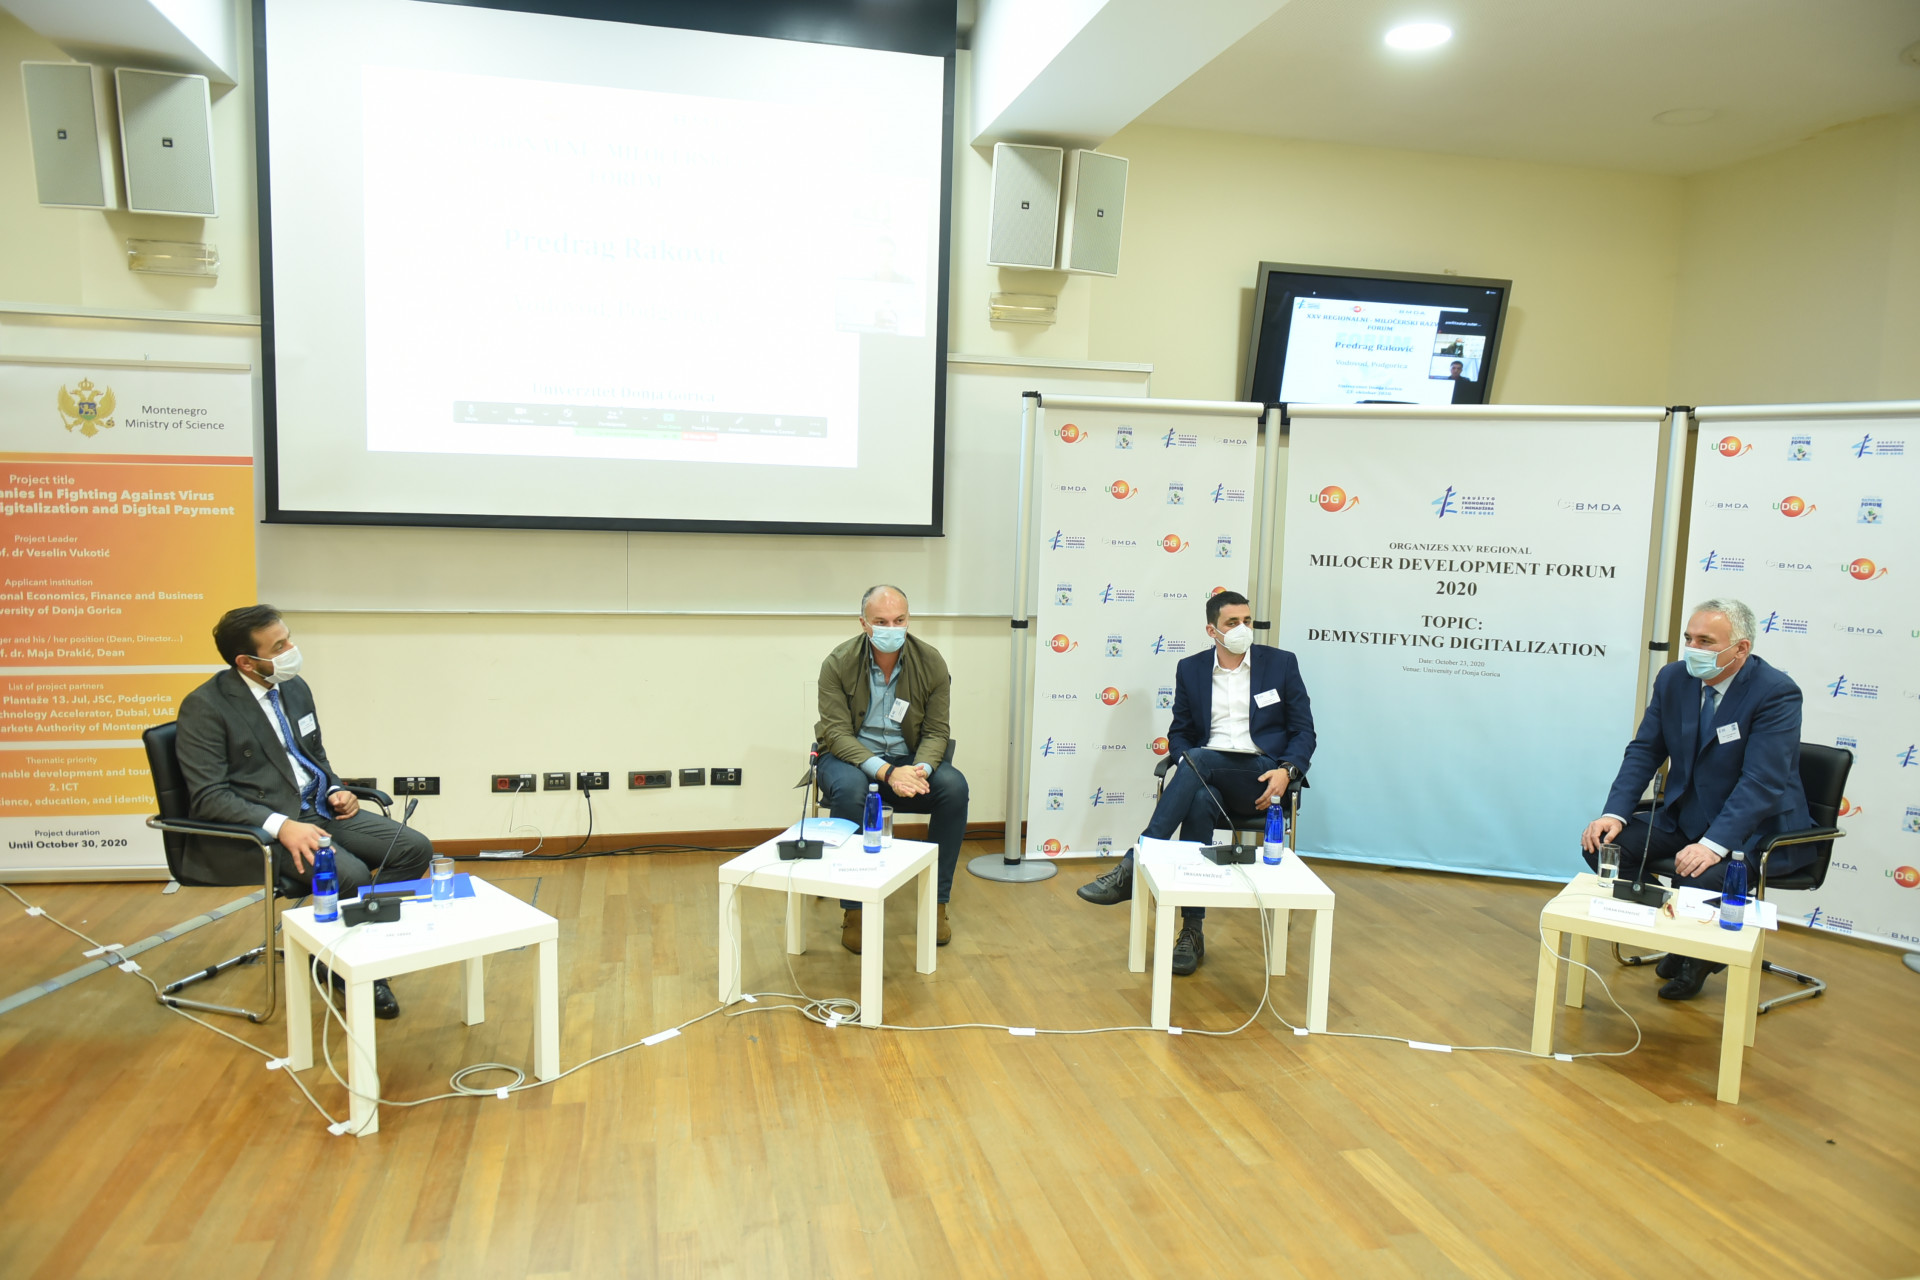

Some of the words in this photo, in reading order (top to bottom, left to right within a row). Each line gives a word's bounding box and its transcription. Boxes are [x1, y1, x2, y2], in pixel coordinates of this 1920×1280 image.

[503, 227, 617, 263] Predrag
[1335, 341, 1374, 352] Predrag
[141, 405, 208, 417] Montenegro
[125, 419, 169, 431] Ministry
[172, 419, 183, 430] of
[185, 420, 225, 431] Science
[1053, 429, 1075, 438] UDG
[1711, 442, 1736, 451] UDG
[9, 474, 50, 487] Project
[52, 475, 76, 485] title
[39, 487, 53, 499] in
[57, 488, 118, 503] Fighting
[121, 489, 176, 503] Against
[178, 490, 215, 501] Virus
[1105, 485, 1125, 494] UDG
[1309, 492, 1340, 504] UDG
[92, 504, 119, 514] and
[122, 503, 171, 517] Digital
[174, 504, 235, 518] Payment
[1575, 502, 1622, 512] BMDA
[1772, 502, 1799, 511] UDG
[15, 534, 45, 544] Project
[48, 534, 78, 543] Leader
[1157, 539, 1177, 547] UDG
[12, 547, 24, 557] dr
[26, 548, 67, 557] Veselin
[69, 548, 111, 558] Vukotić
[1389, 541, 1449, 552] ORGANIZES
[1451, 544, 1474, 554] XXV
[1476, 544, 1532, 555] REGIONAL
[1309, 553, 1394, 570] MILOCER
[1399, 557, 1541, 577] DEVELOPMENT
[1545, 563, 1617, 579] FORUM
[1778, 562, 1813, 570] BMDA
[1841, 564, 1869, 574] UDG
[5, 578, 48, 588] Applicant
[1435, 580, 1478, 597] 2020
[27, 591, 88, 601] Economics,
[91, 591, 132, 600] Finance
[135, 591, 155, 600] and
[158, 591, 204, 600] Business
[37, 605, 50, 615] of
[52, 605, 84, 617] Donja
[86, 605, 122, 615] Gorica
[1421, 614, 1484, 632] TOPIC:
[14, 635, 31, 644] and
[33, 635, 45, 643] his
[53, 635, 67, 643] her
[70, 635, 104, 645] position
[106, 634, 135, 644] (Dean,
[1045, 639, 1065, 648] UDG
[1308, 628, 1445, 650] DEMYSTIFYING
[1450, 636, 1607, 658] DIGITALIZATION
[10, 648, 25, 658] dr.
[27, 648, 54, 659] Maja
[57, 648, 94, 658] Drakić,
[97, 648, 125, 657] Dean
[1435, 658, 1458, 666] October
[1402, 665, 1421, 673] Venue:
[1423, 667, 1452, 675] University
[1462, 669, 1480, 677] Donja
[8, 682, 23, 691] List
[25, 682, 34, 690] of
[36, 682, 67, 692] project
[69, 682, 104, 691] partners
[3, 695, 49, 705] Plantaže
[52, 695, 69, 704] 13.
[71, 695, 90, 704] Jul,
[92, 694, 116, 704] JSC,
[118, 693, 172, 704] Podgorica
[1095, 692, 1116, 700] UDG
[50, 709, 113, 719] Accelerator,
[115, 708, 150, 718] Dubai,
[153, 707, 175, 716] UAE
[36, 723, 86, 734] Authority
[88, 722, 100, 732] of
[1146, 742, 1168, 751] UDG
[26, 756, 65, 764] Thematic
[66, 756, 97, 765] priority
[33, 768, 104, 779] development
[106, 767, 126, 777] and
[49, 783, 59, 791] 2.
[62, 782, 79, 791] ICT
[35, 796, 90, 806] education,
[92, 796, 112, 805] and
[114, 794, 155, 806] identity
[34, 829, 63, 838] Project
[65, 828, 100, 837] duration
[8, 840, 33, 849] Until
[36, 839, 79, 849] October
[81, 840, 98, 849] 30,
[100, 839, 128, 847] 2020
[1037, 844, 1057, 852] UDG
[1831, 861, 1858, 871] MDA
[1885, 869, 1915, 882] UDG
[1891, 932, 1920, 943] BMD
